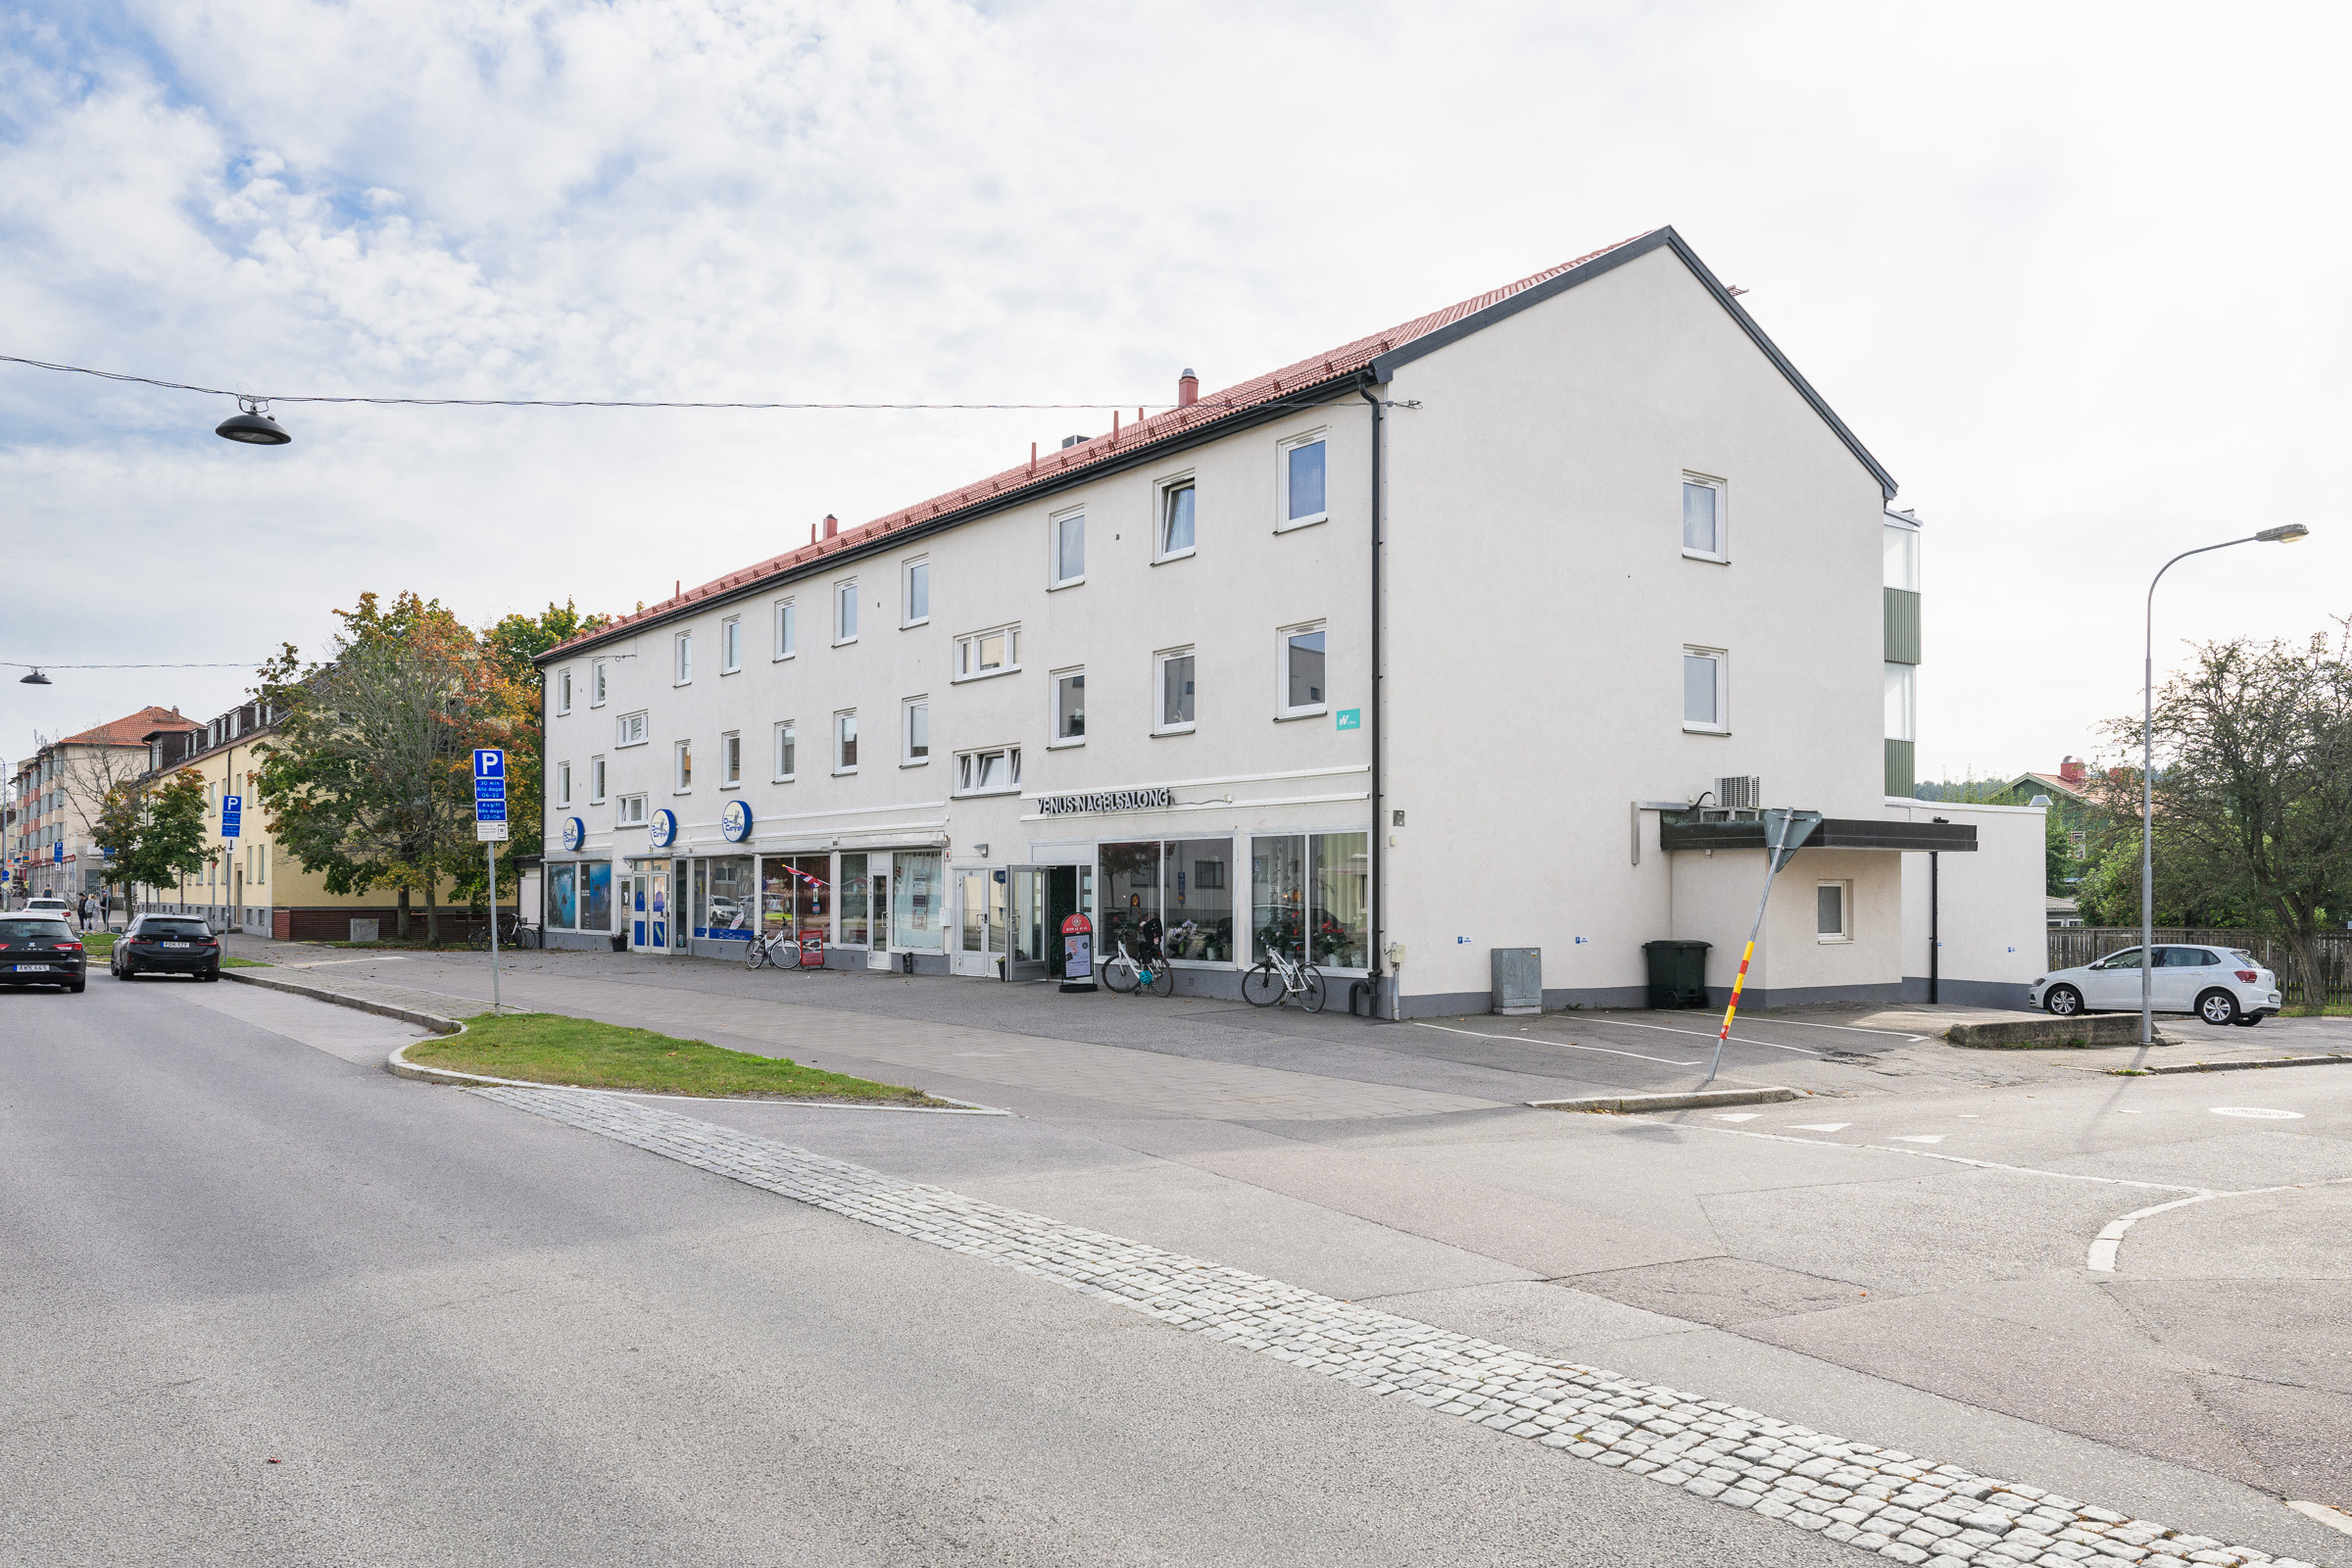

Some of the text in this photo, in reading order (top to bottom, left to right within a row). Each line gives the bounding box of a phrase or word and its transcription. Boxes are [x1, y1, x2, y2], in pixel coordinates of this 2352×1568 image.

[481, 752, 499, 775] P
[227, 797, 239, 810] P
[1037, 789, 1169, 814] VENUS NAGELSALONG
